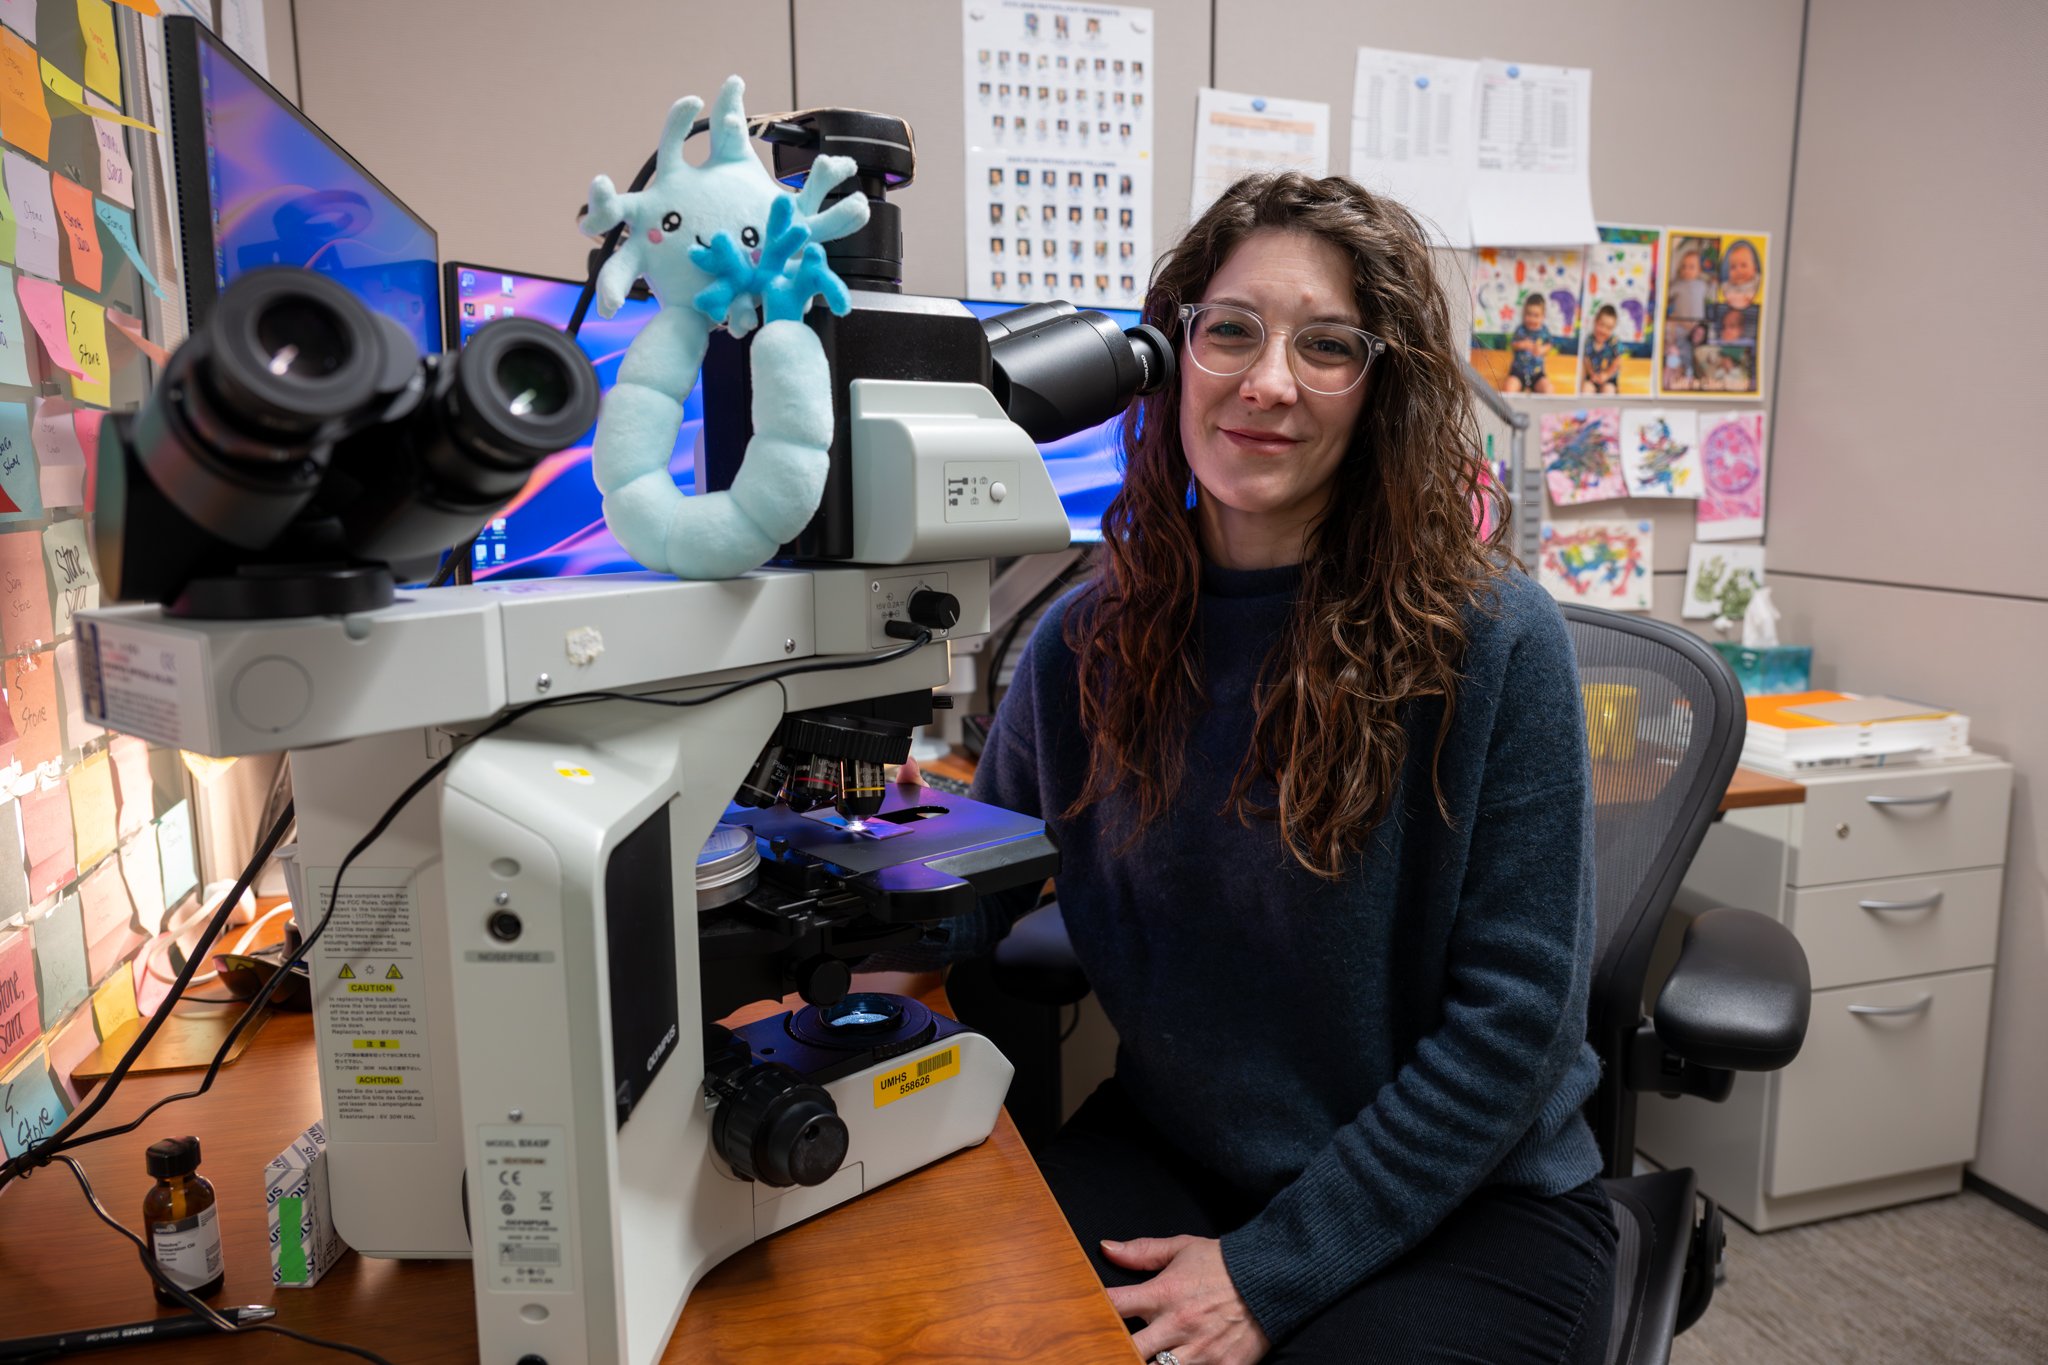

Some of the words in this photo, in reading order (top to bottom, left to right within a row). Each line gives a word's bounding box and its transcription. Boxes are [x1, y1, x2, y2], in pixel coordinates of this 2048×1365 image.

[78, 343, 101, 366] Stone
[54, 544, 91, 585] Stone,
[21, 705, 48, 737] Stone
[0, 969, 25, 1016] tone,
[350, 983, 393, 993] CAUTION
[646, 1023, 676, 1072] OLYMPUS
[358, 1075, 401, 1085] ACHTUNG
[880, 1071, 908, 1091] UMHS
[900, 1074, 931, 1095] 558626
[17, 1107, 55, 1149] Stone
[485, 1138, 517, 1149] MODEL
[266, 1185, 284, 1205] US
